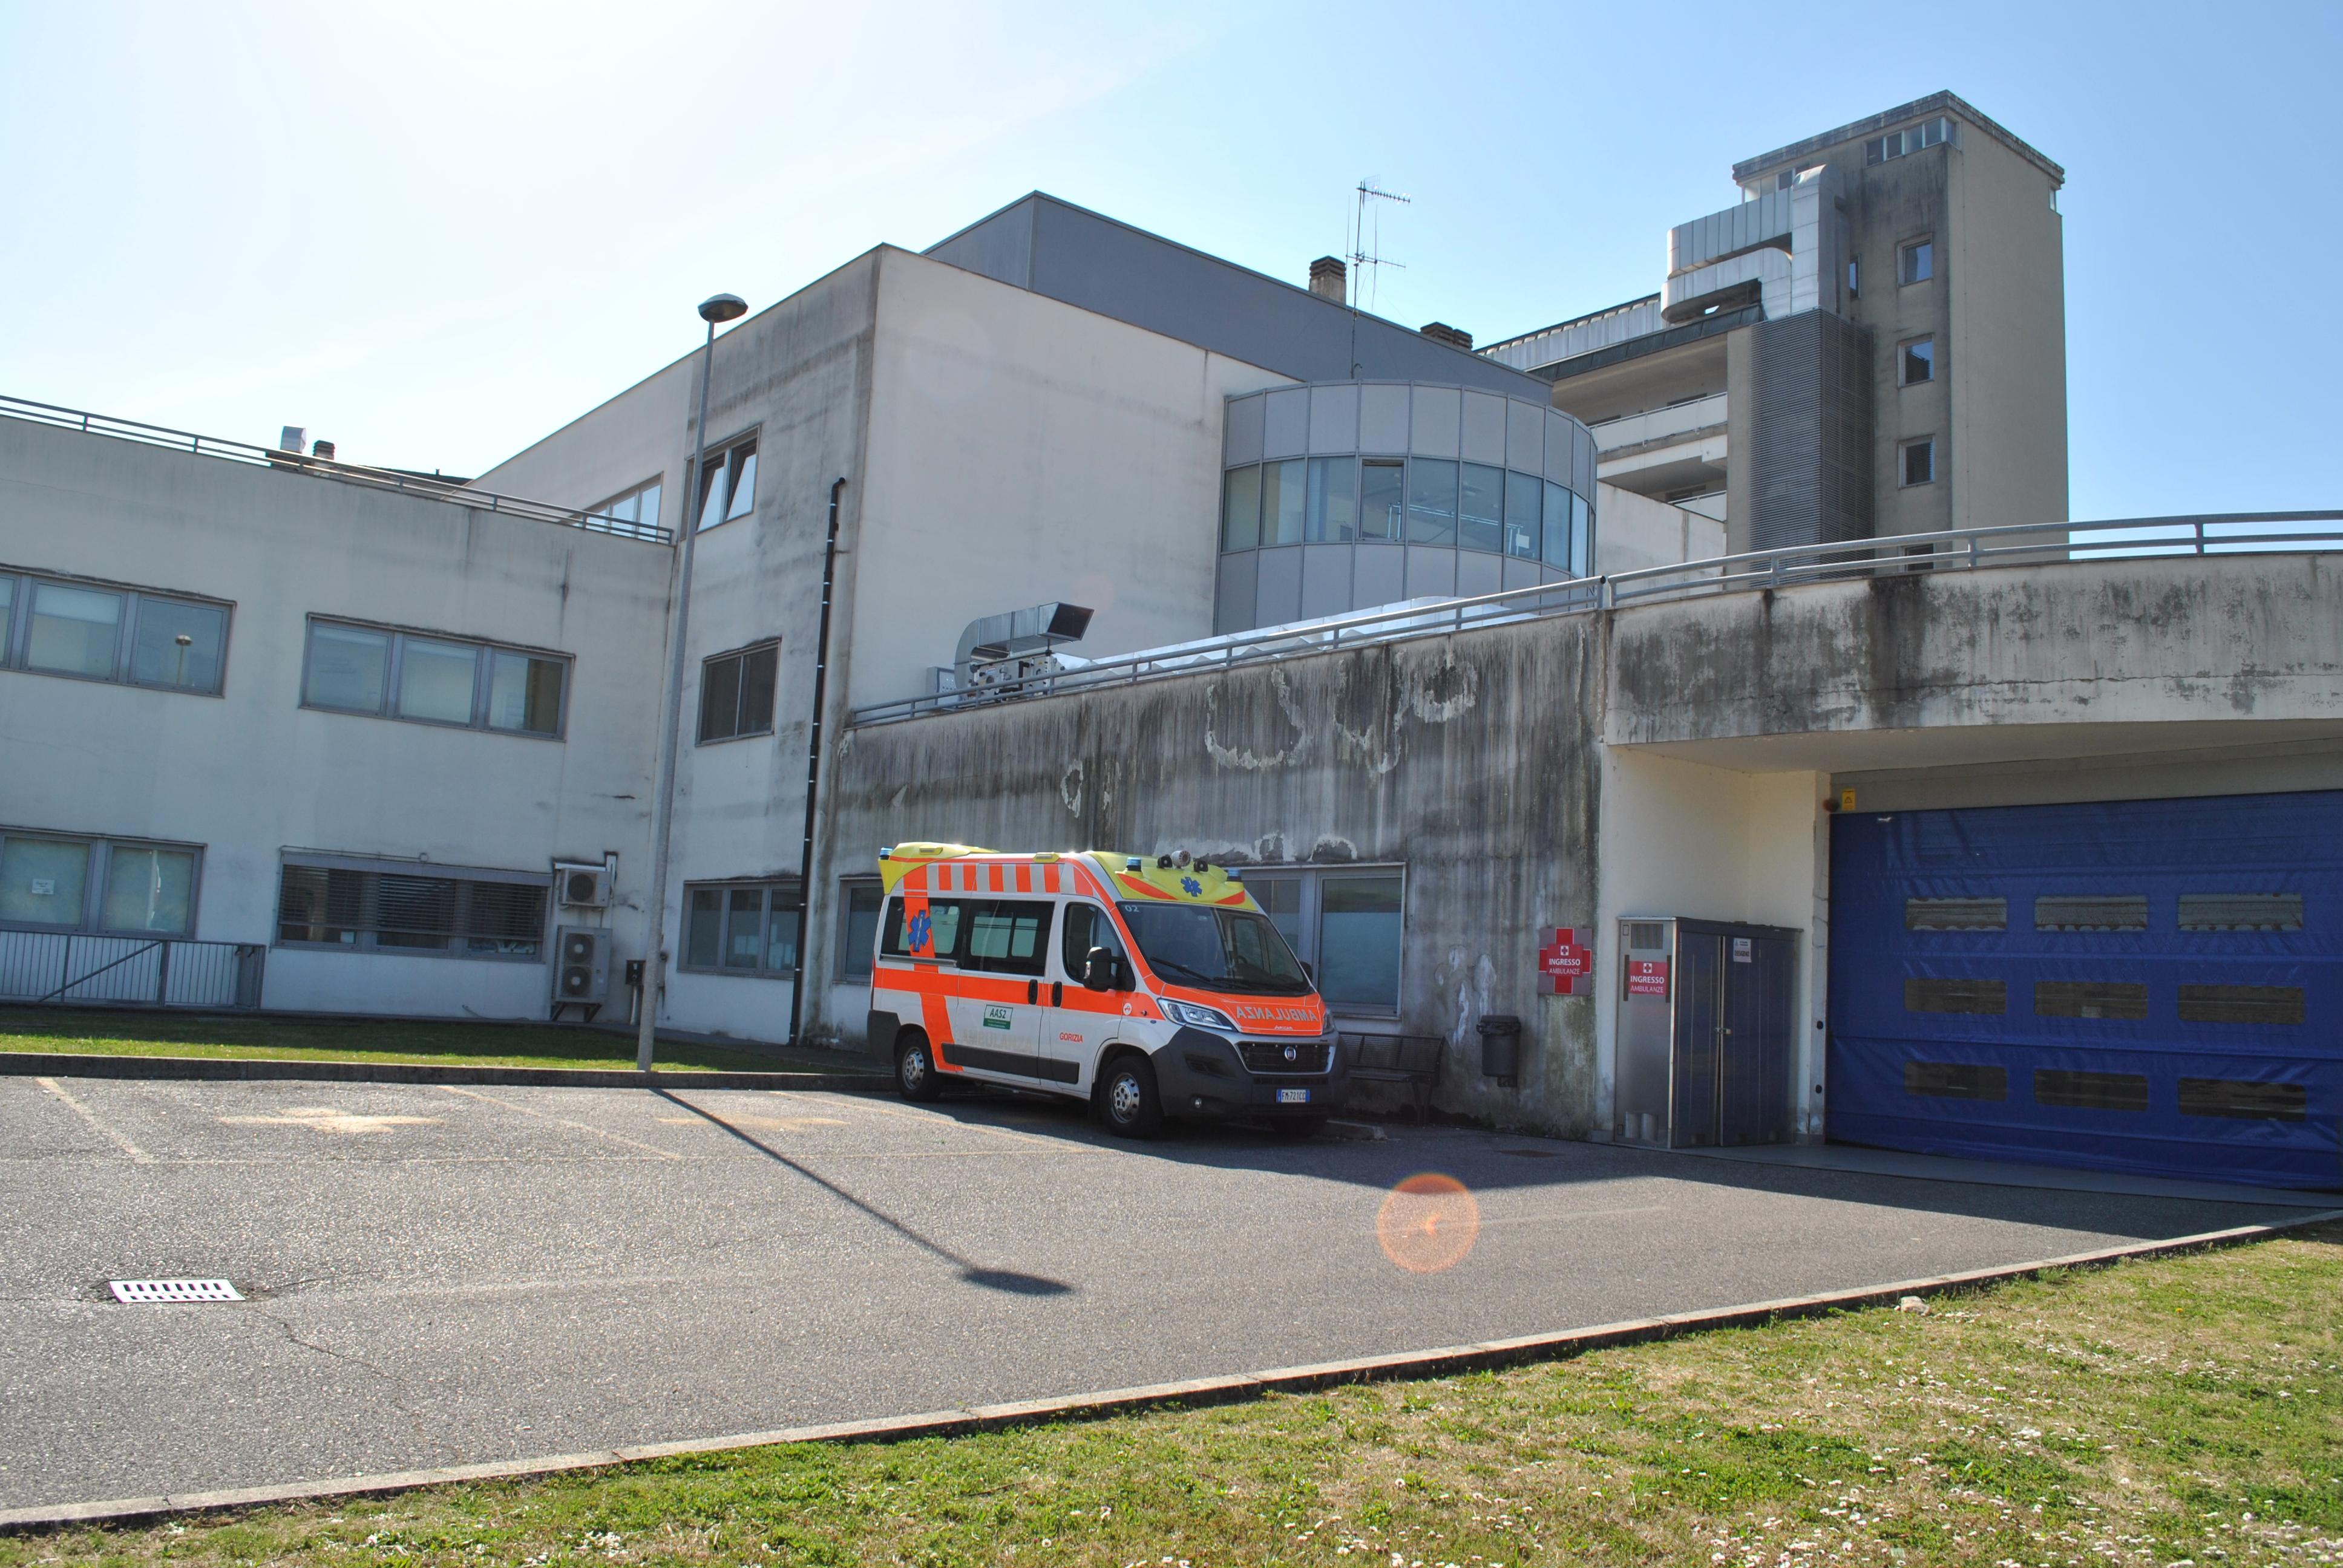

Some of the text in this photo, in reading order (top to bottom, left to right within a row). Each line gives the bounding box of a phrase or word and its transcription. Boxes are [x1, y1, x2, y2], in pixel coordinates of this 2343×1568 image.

[1630, 975, 1665, 984] INGRESSO
[1630, 985, 1663, 993] AMBULANZE
[989, 1008, 1007, 1019] AAS2
[1060, 1032, 1083, 1042] GORIZIA
